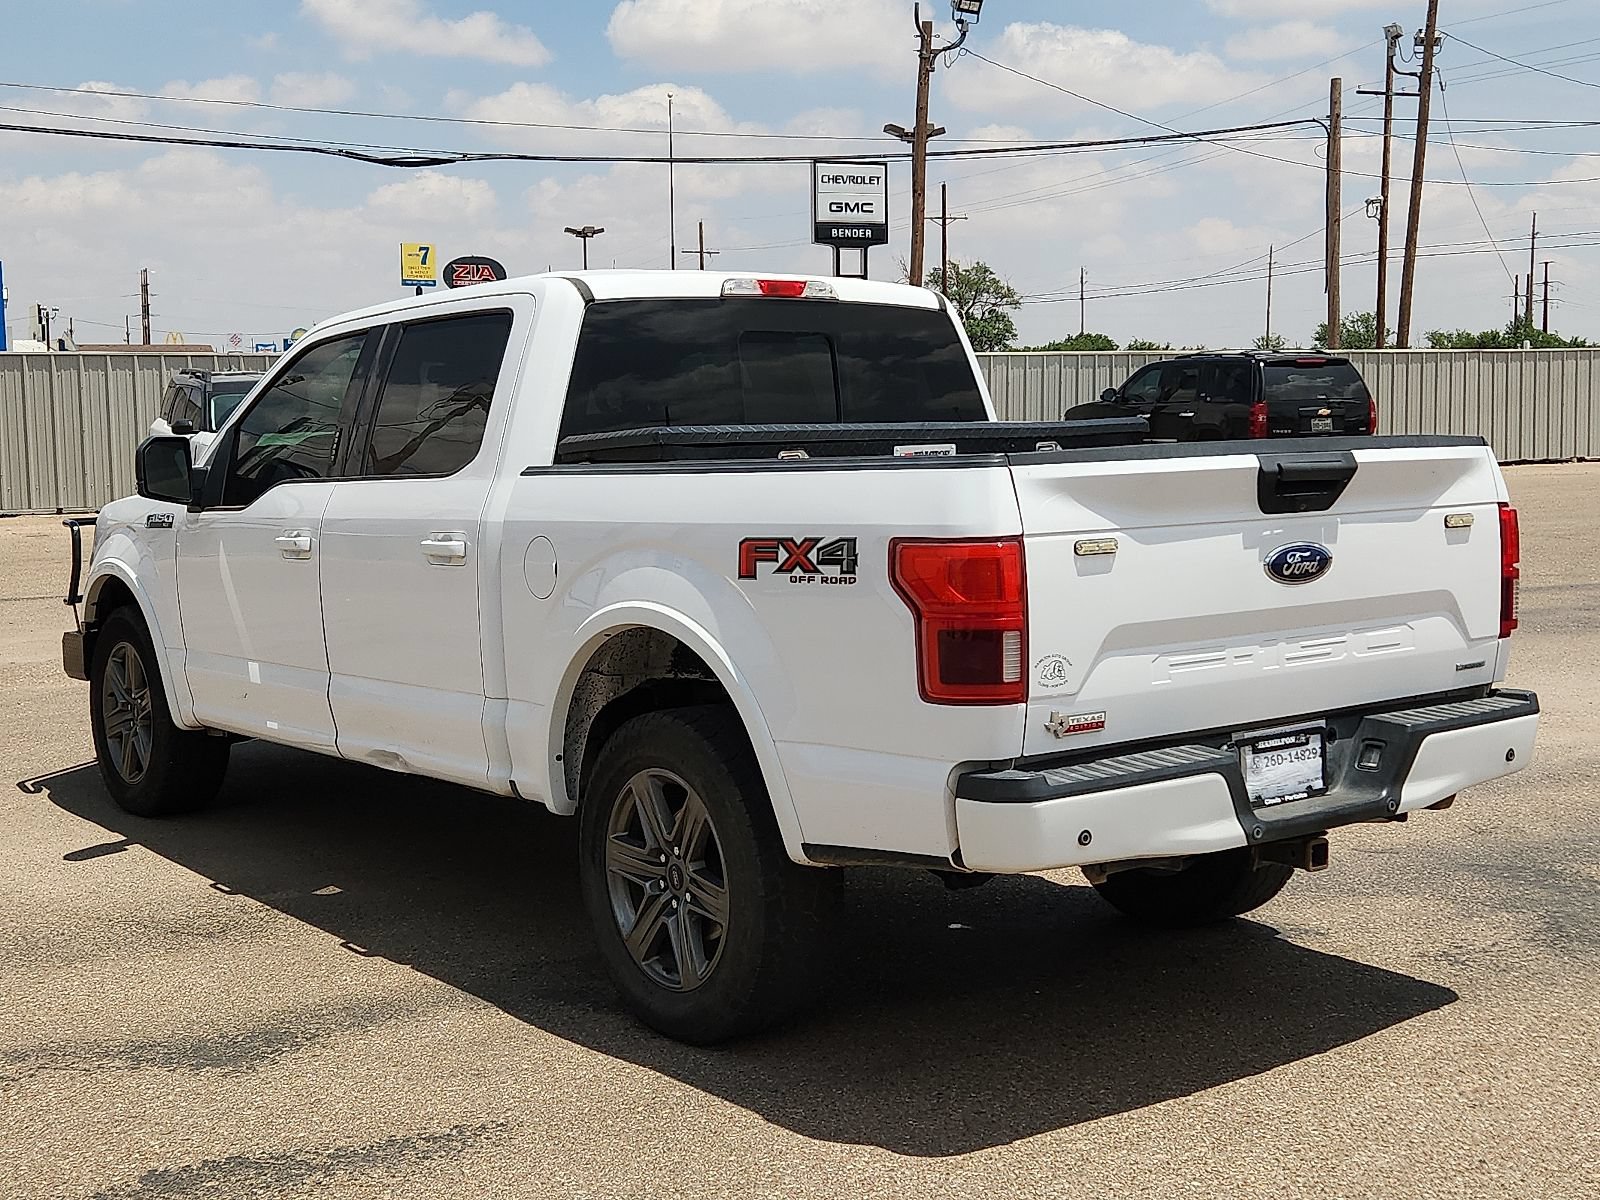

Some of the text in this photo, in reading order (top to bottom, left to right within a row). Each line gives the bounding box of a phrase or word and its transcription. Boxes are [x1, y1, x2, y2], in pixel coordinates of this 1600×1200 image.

[821, 174, 881, 186] CHEVROLET
[829, 202, 874, 213] GMC
[831, 228, 872, 238] BENDER
[418, 246, 430, 265] 7
[451, 264, 497, 280] ZIA
[738, 537, 859, 581] FX4
[1282, 550, 1321, 575] Ford
[790, 576, 857, 585] OFF ROAD
[1069, 714, 1103, 724] TEXAS
[1069, 722, 1103, 731] EDITION
